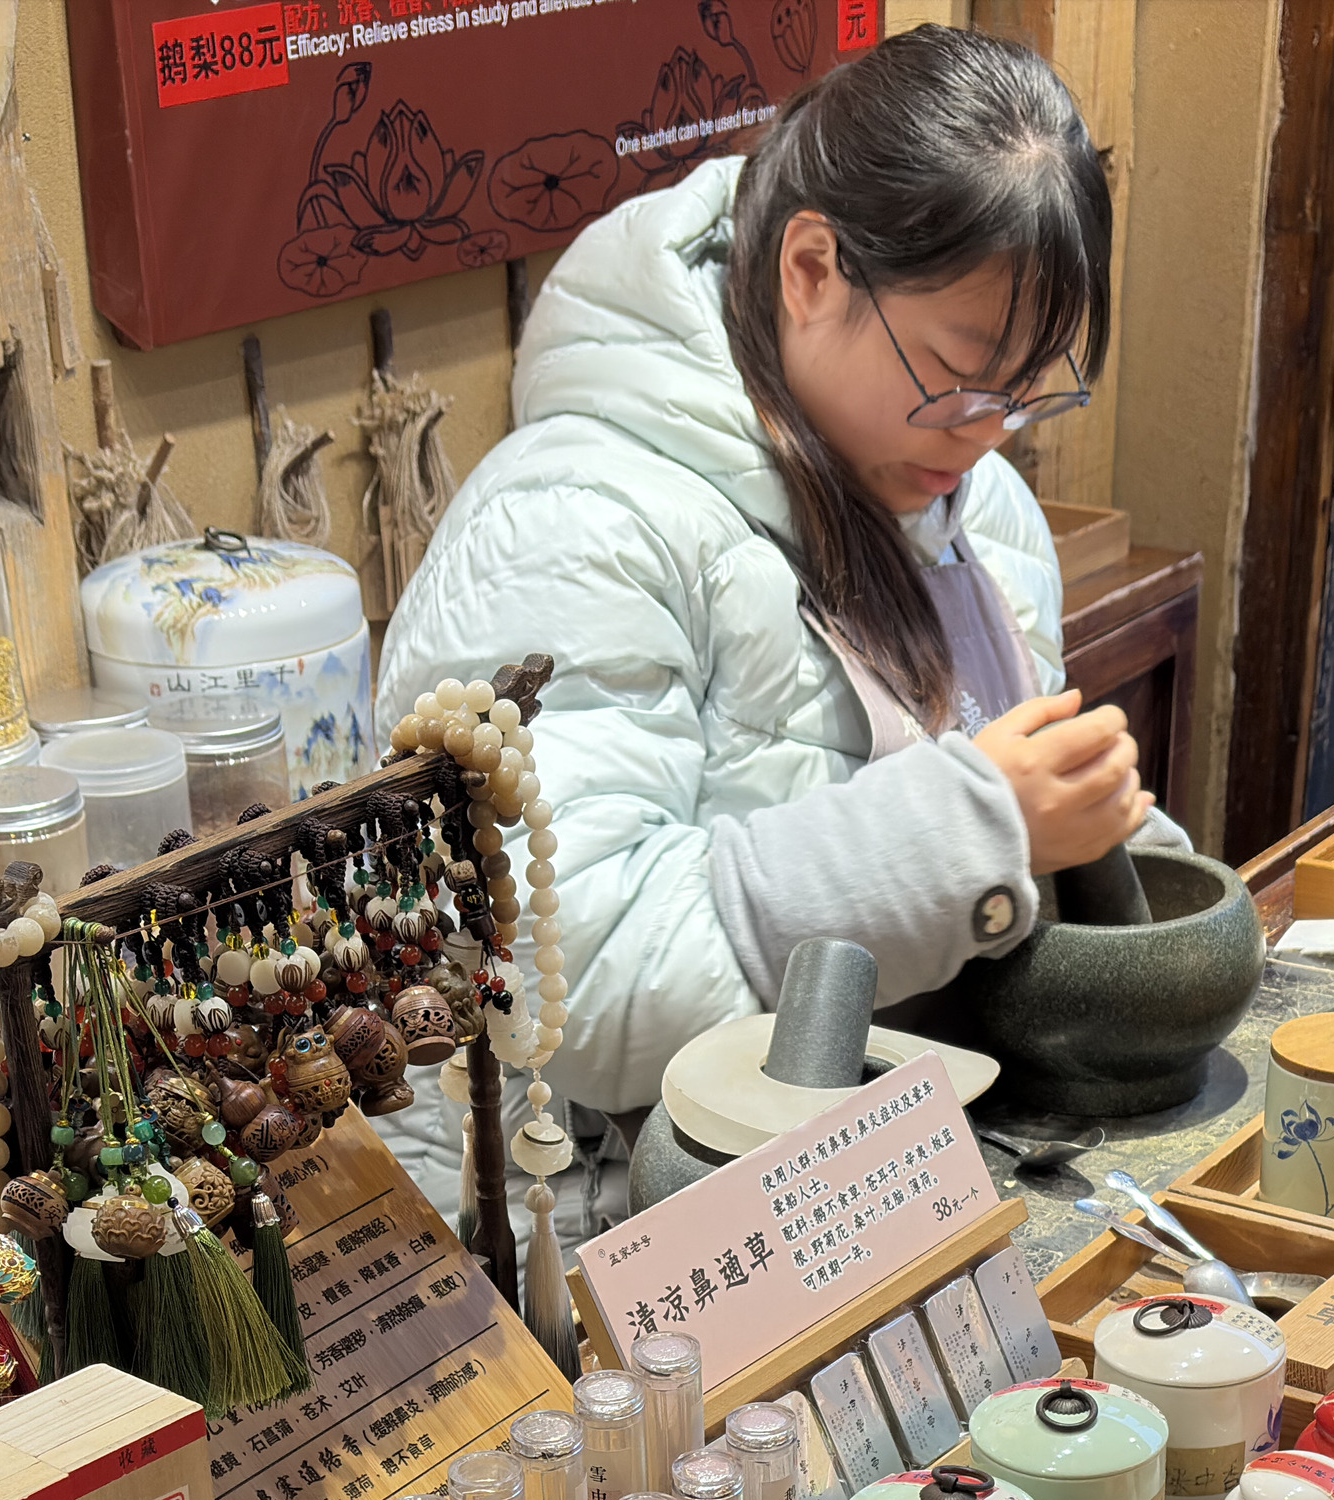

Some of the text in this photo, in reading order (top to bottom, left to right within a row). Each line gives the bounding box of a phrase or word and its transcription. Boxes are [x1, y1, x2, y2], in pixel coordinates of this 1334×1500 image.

[159, 25, 284, 87] 鹅梨88元
[286, 31, 351, 61] Efficacy:
[353, 21, 408, 47] Relieve
[410, 15, 455, 37] stress
[456, 8, 470, 28] in
[471, 2, 510, 30] study
[929, 1178, 982, 1223] 38元一个
[606, 1231, 653, 1268] 孟家老号
[621, 1226, 780, 1349] 清凉鼻通草
